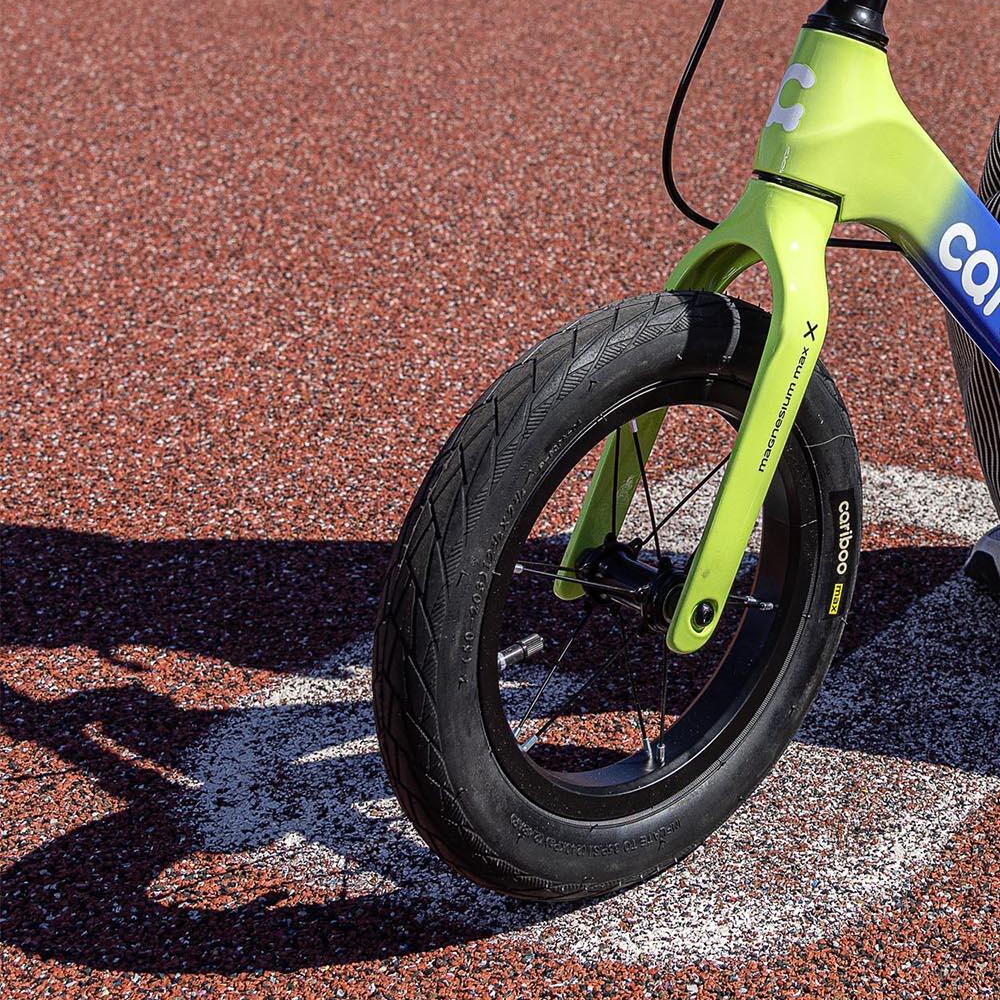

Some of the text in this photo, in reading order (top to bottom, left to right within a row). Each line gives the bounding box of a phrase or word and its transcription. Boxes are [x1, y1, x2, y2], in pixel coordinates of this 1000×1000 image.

[758, 382, 796, 472] magnesium
[794, 347, 809, 379] max
[837, 501, 853, 575] cariboo
[831, 585, 842, 612] max
